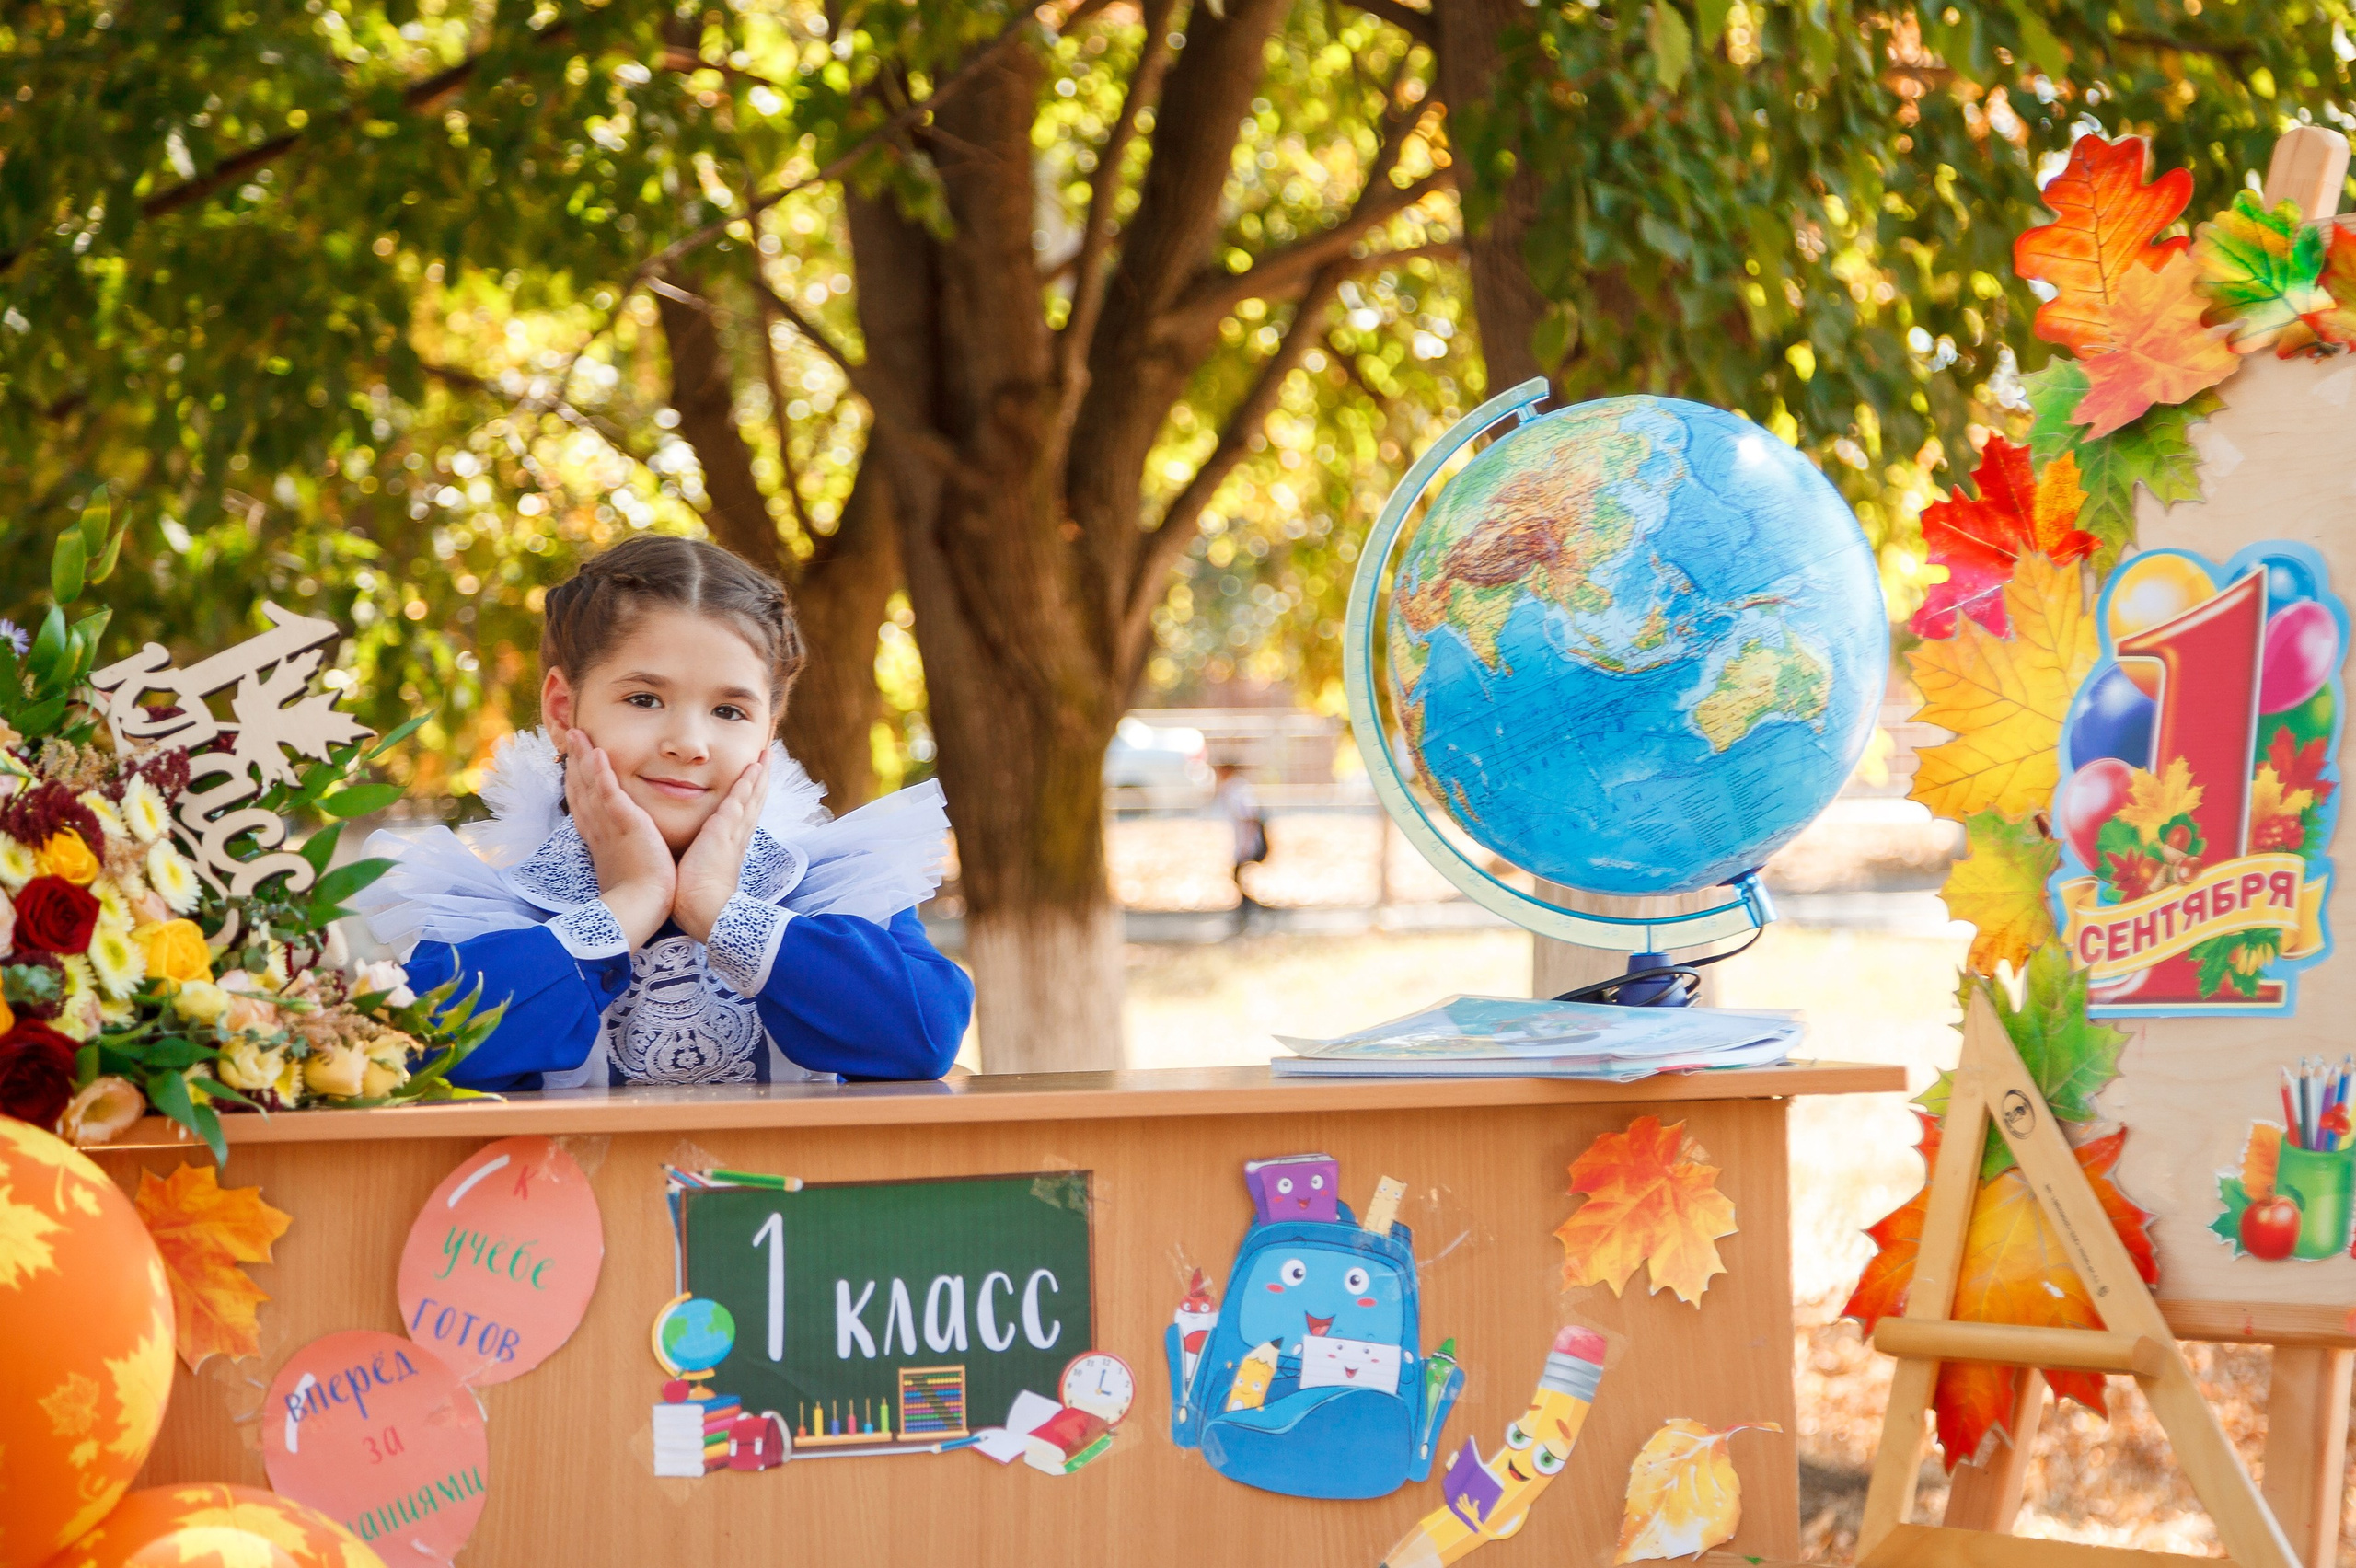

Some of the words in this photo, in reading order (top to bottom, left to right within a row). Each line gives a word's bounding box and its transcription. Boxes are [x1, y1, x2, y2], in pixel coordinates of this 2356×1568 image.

[178, 600, 340, 698] 1
[2088, 564, 2286, 1008] 1
[2079, 870, 2298, 964] СЕНТЯБРЯ
[433, 1225, 556, 1290] учёбе
[752, 1212, 785, 1362] 1
[836, 1269, 1060, 1359] класс
[284, 1350, 418, 1422] вперёд
[363, 1426, 405, 1465] за
[346, 1465, 486, 1541] аниями
